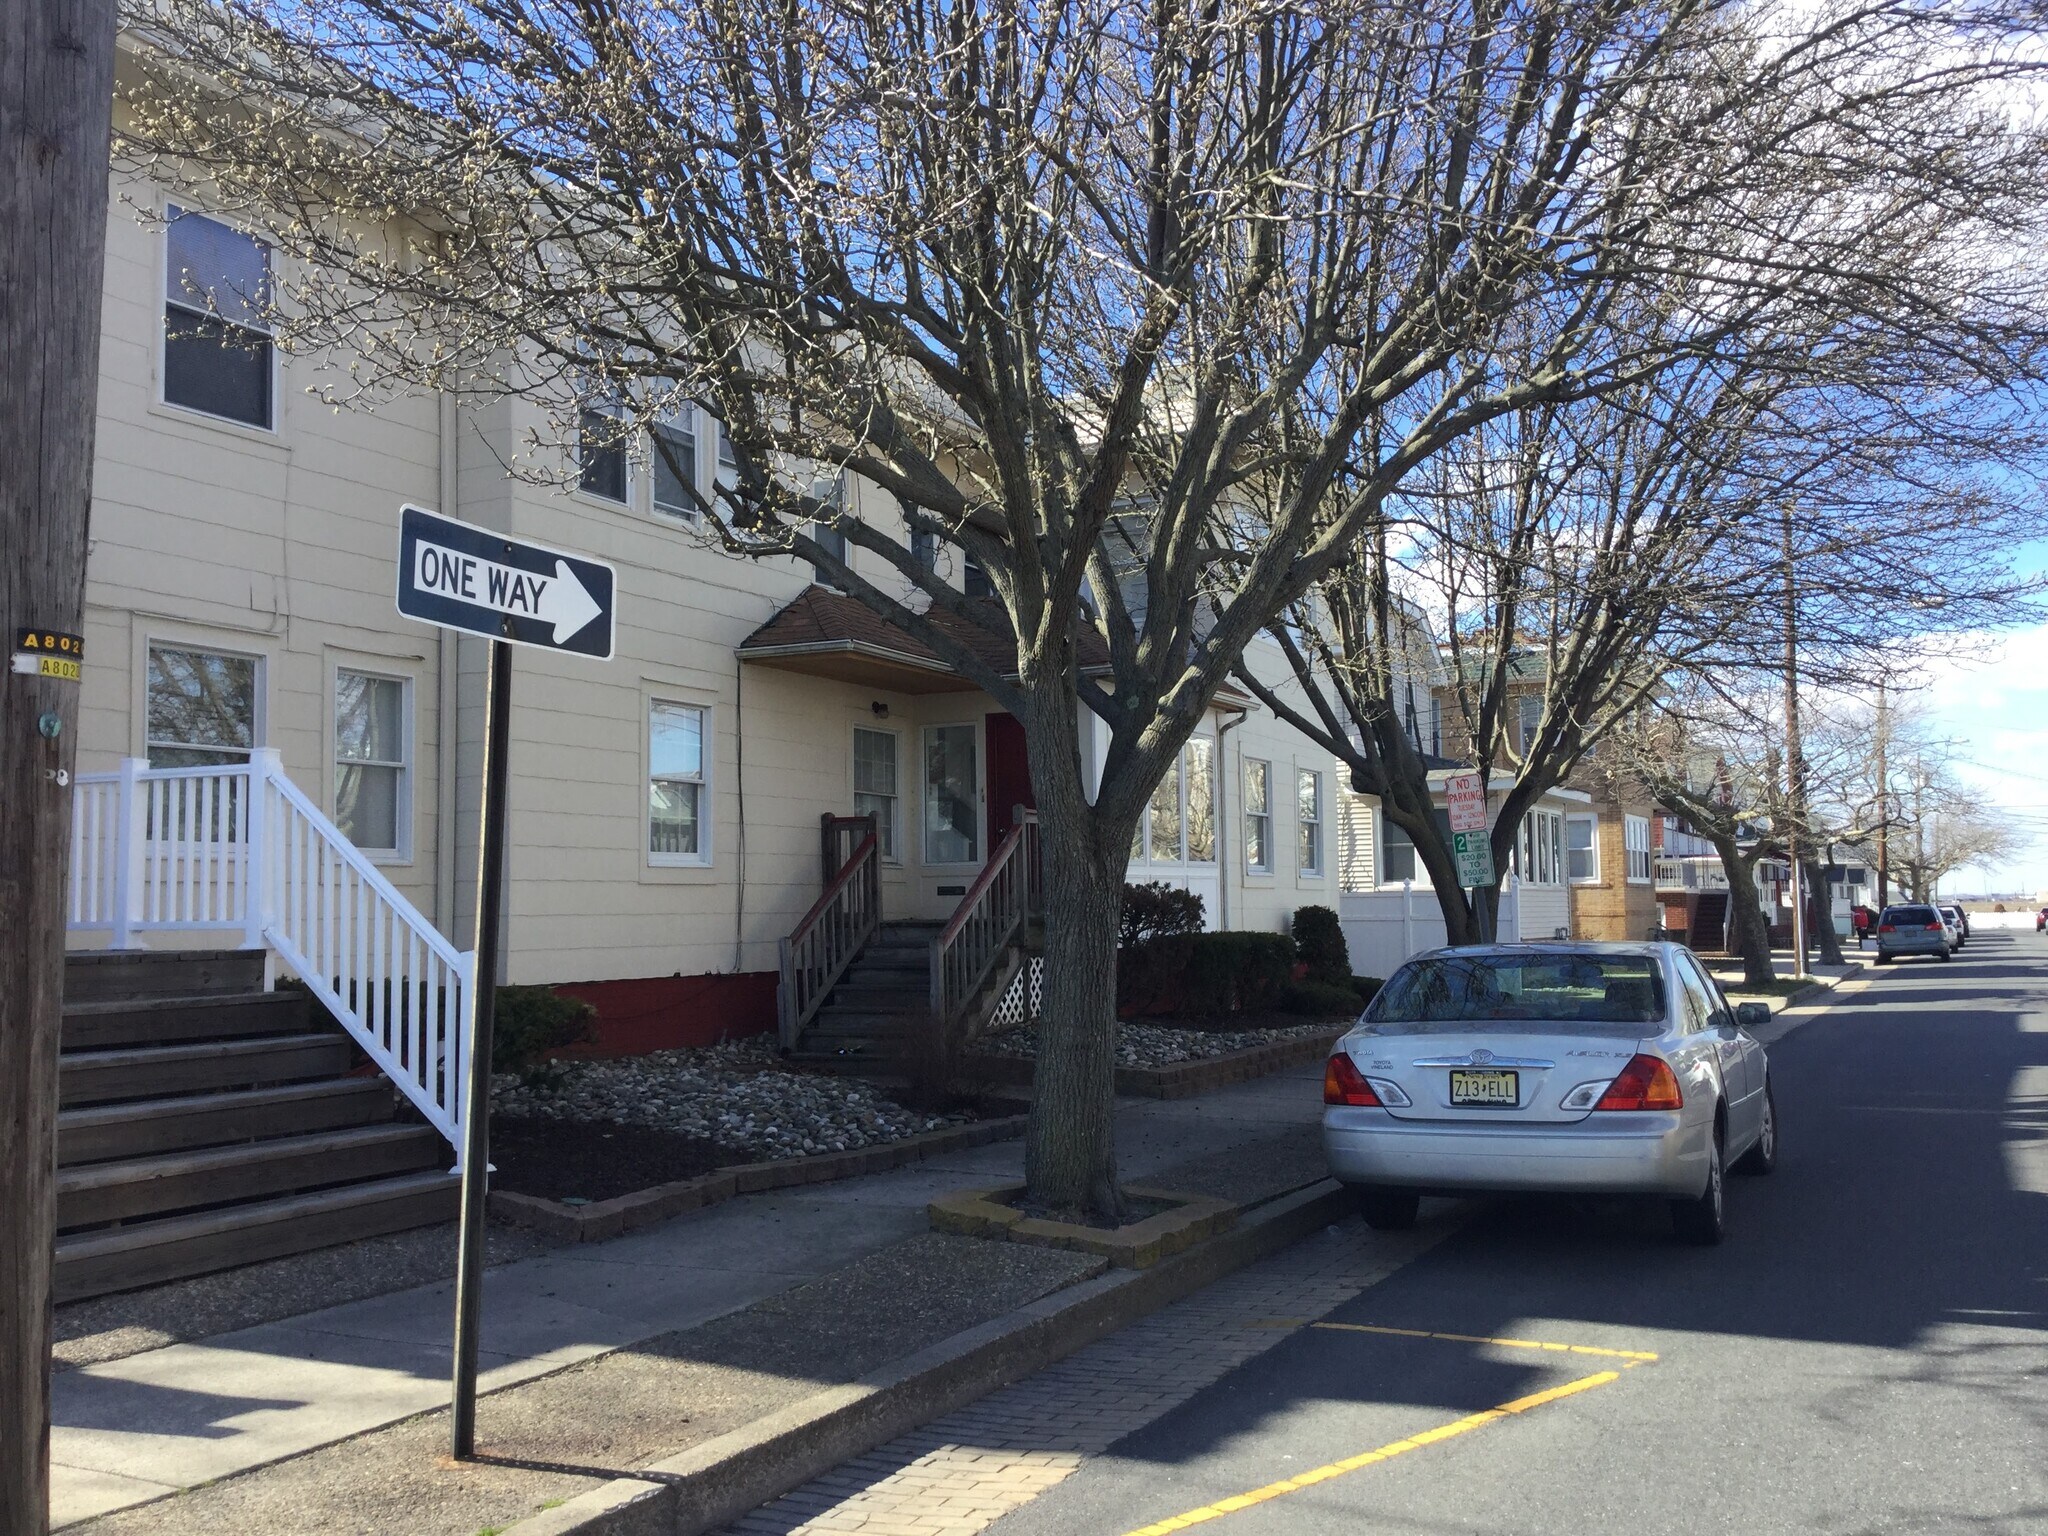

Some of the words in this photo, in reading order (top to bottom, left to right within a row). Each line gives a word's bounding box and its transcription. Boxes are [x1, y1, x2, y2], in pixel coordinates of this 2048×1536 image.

[421, 547, 477, 600] ONE
[488, 566, 547, 615] WAY
[1456, 778, 1470, 790] NO
[1448, 790, 1482, 804] PARKING
[1457, 836, 1466, 850] 2
[1461, 853, 1487, 861] $20.00
[1463, 868, 1489, 877] $50.00
[1489, 1081, 1513, 1098] ELL
